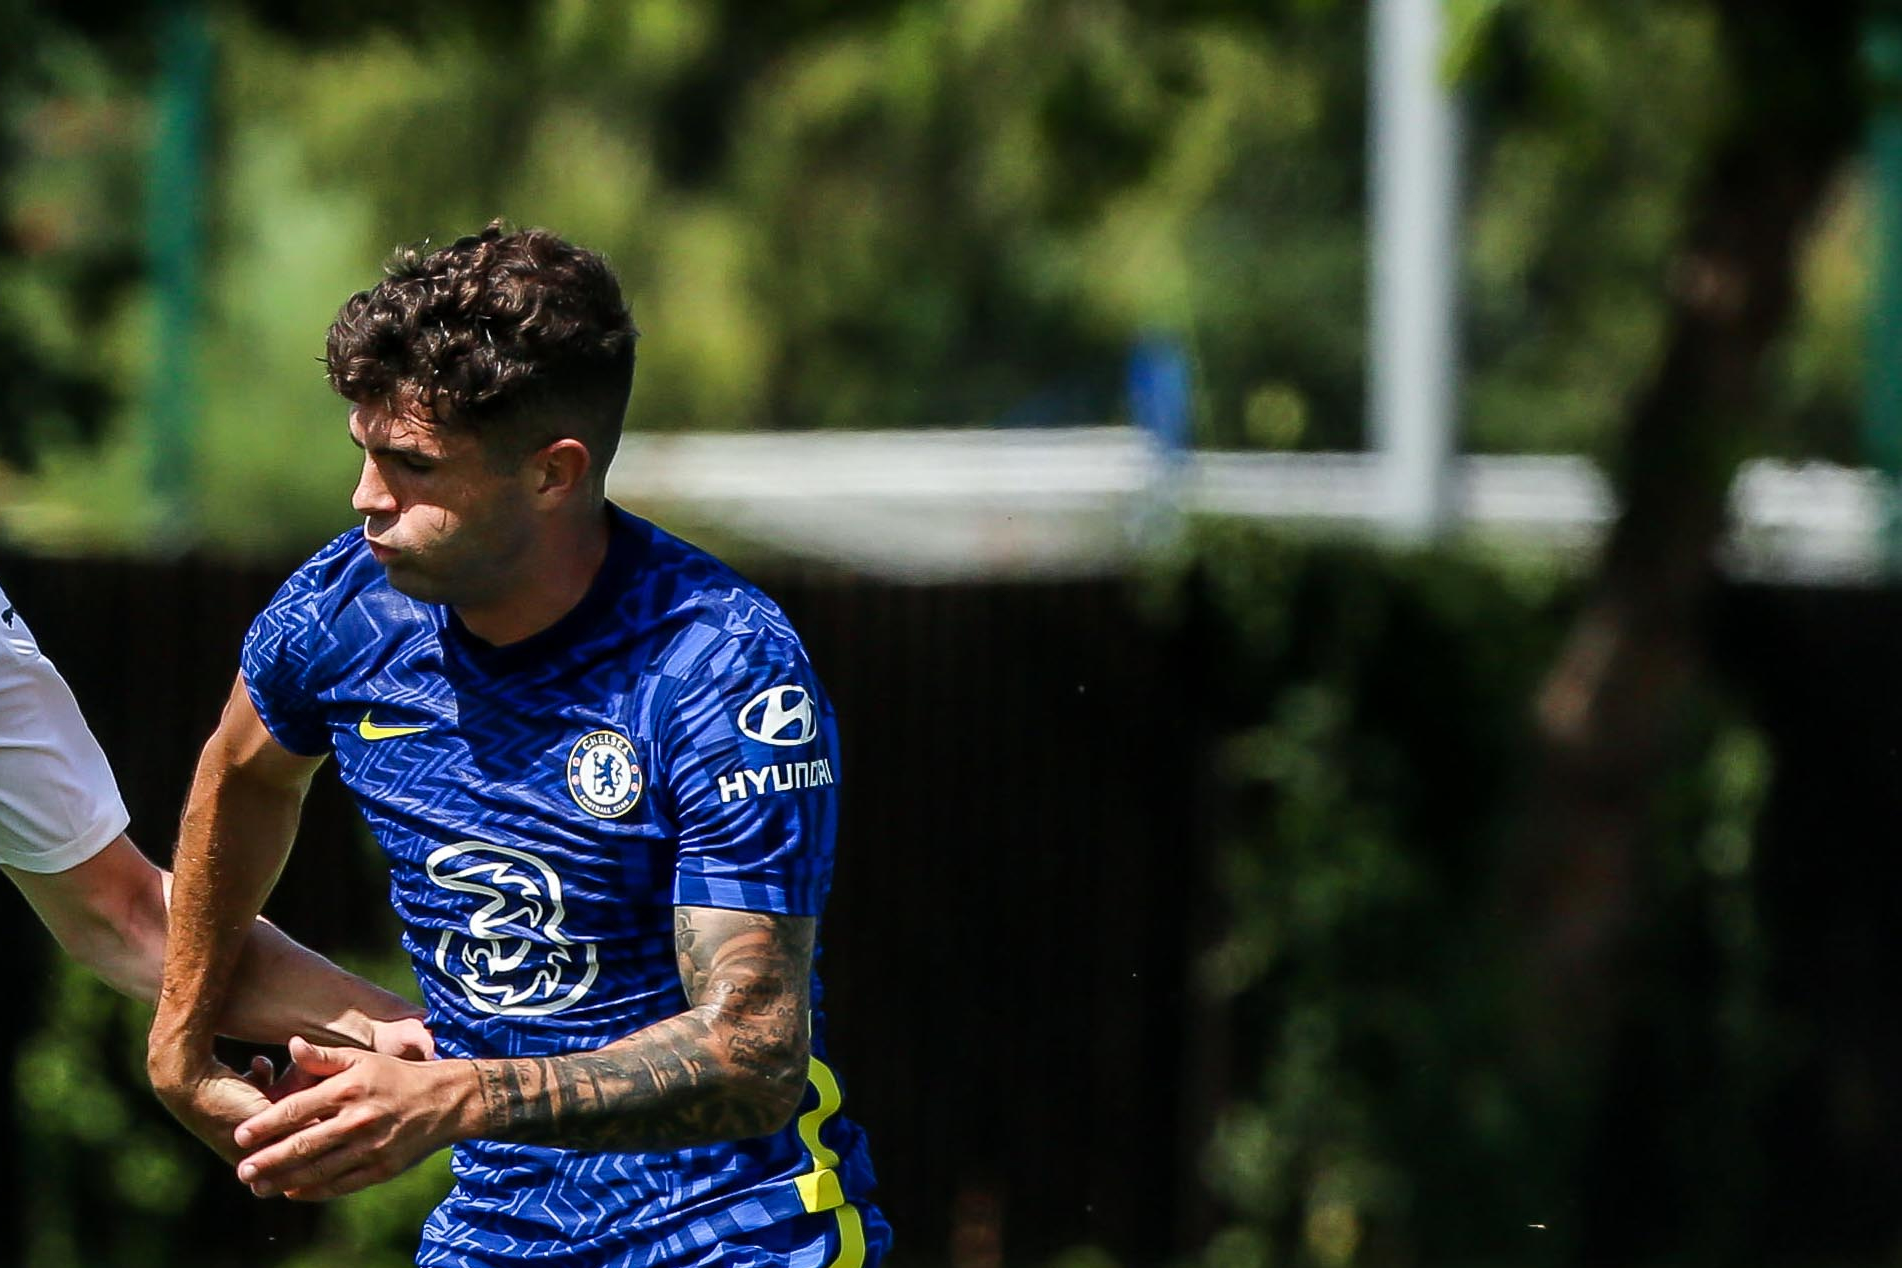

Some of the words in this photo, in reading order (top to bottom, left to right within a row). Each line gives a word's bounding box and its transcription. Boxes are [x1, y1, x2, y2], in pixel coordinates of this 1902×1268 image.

[582, 734, 630, 755] CHELSEA
[717, 758, 834, 803] HYUNDAI
[579, 794, 612, 814] FOOTBALL
[613, 799, 630, 812] CLUB
